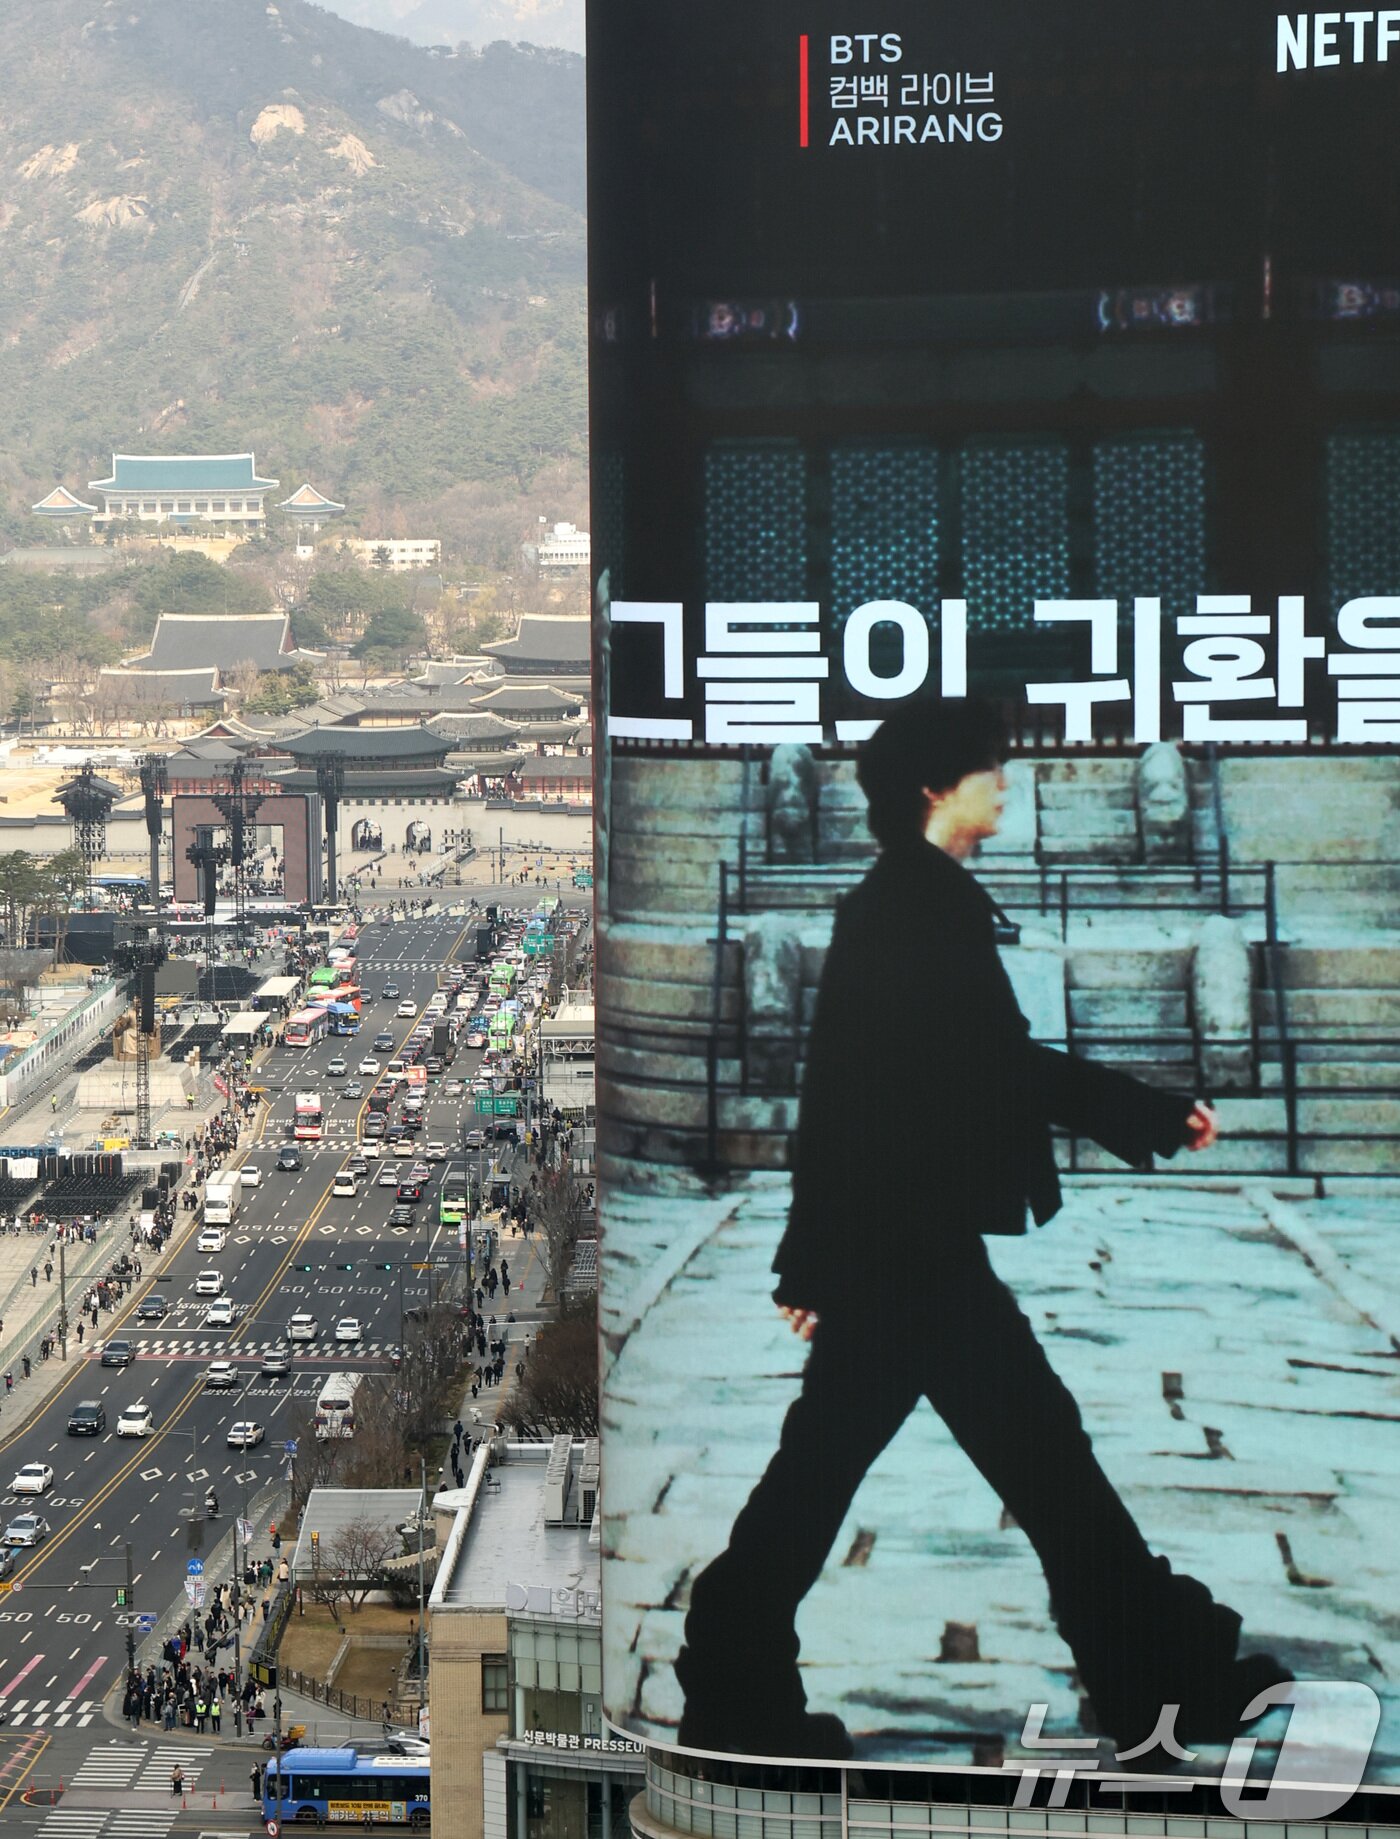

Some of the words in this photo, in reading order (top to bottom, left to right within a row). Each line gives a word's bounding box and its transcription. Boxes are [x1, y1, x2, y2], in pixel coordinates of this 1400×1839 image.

[1276, 9, 1400, 73] NETF
[830, 33, 903, 64] BTS
[829, 75, 889, 109] 컴백
[901, 71, 995, 106] 라이브
[828, 112, 1003, 146] ARIRANG
[608, 598, 967, 743] 그들의
[279, 1285, 305, 1294] 50
[317, 1285, 344, 1294] 50
[356, 1286, 382, 1295] 50
[403, 1287, 429, 1296] 50
[0, 1612, 33, 1623] 50
[56, 1613, 92, 1624] 50
[523, 1729, 580, 1749] 신문박물관
[415, 1794, 428, 1802] 370
